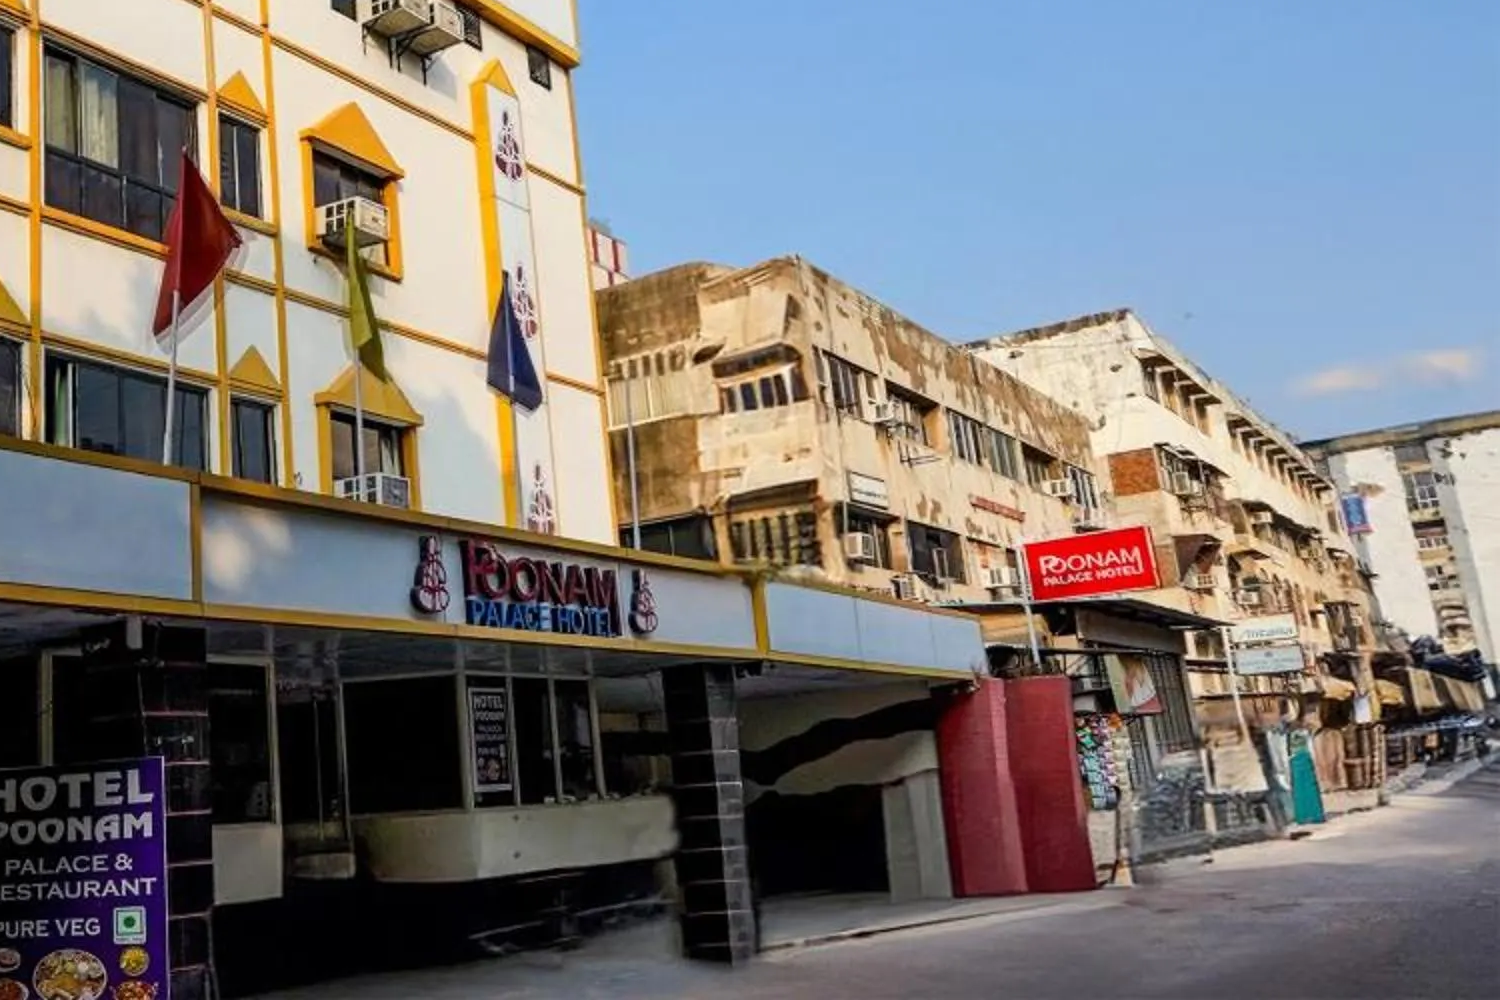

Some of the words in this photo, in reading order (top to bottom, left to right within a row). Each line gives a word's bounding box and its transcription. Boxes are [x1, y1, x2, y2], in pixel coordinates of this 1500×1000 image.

[1038, 546, 1144, 575] POONAM
[459, 536, 620, 636] POONAM
[1043, 571, 1093, 587] PALACE
[1095, 565, 1141, 579] HOTEL
[466, 599, 550, 630] PALACE
[552, 605, 614, 637] HOTEL
[5, 855, 109, 876] PALACE
[115, 853, 134, 871] &
[55, 918, 101, 936] VEG
